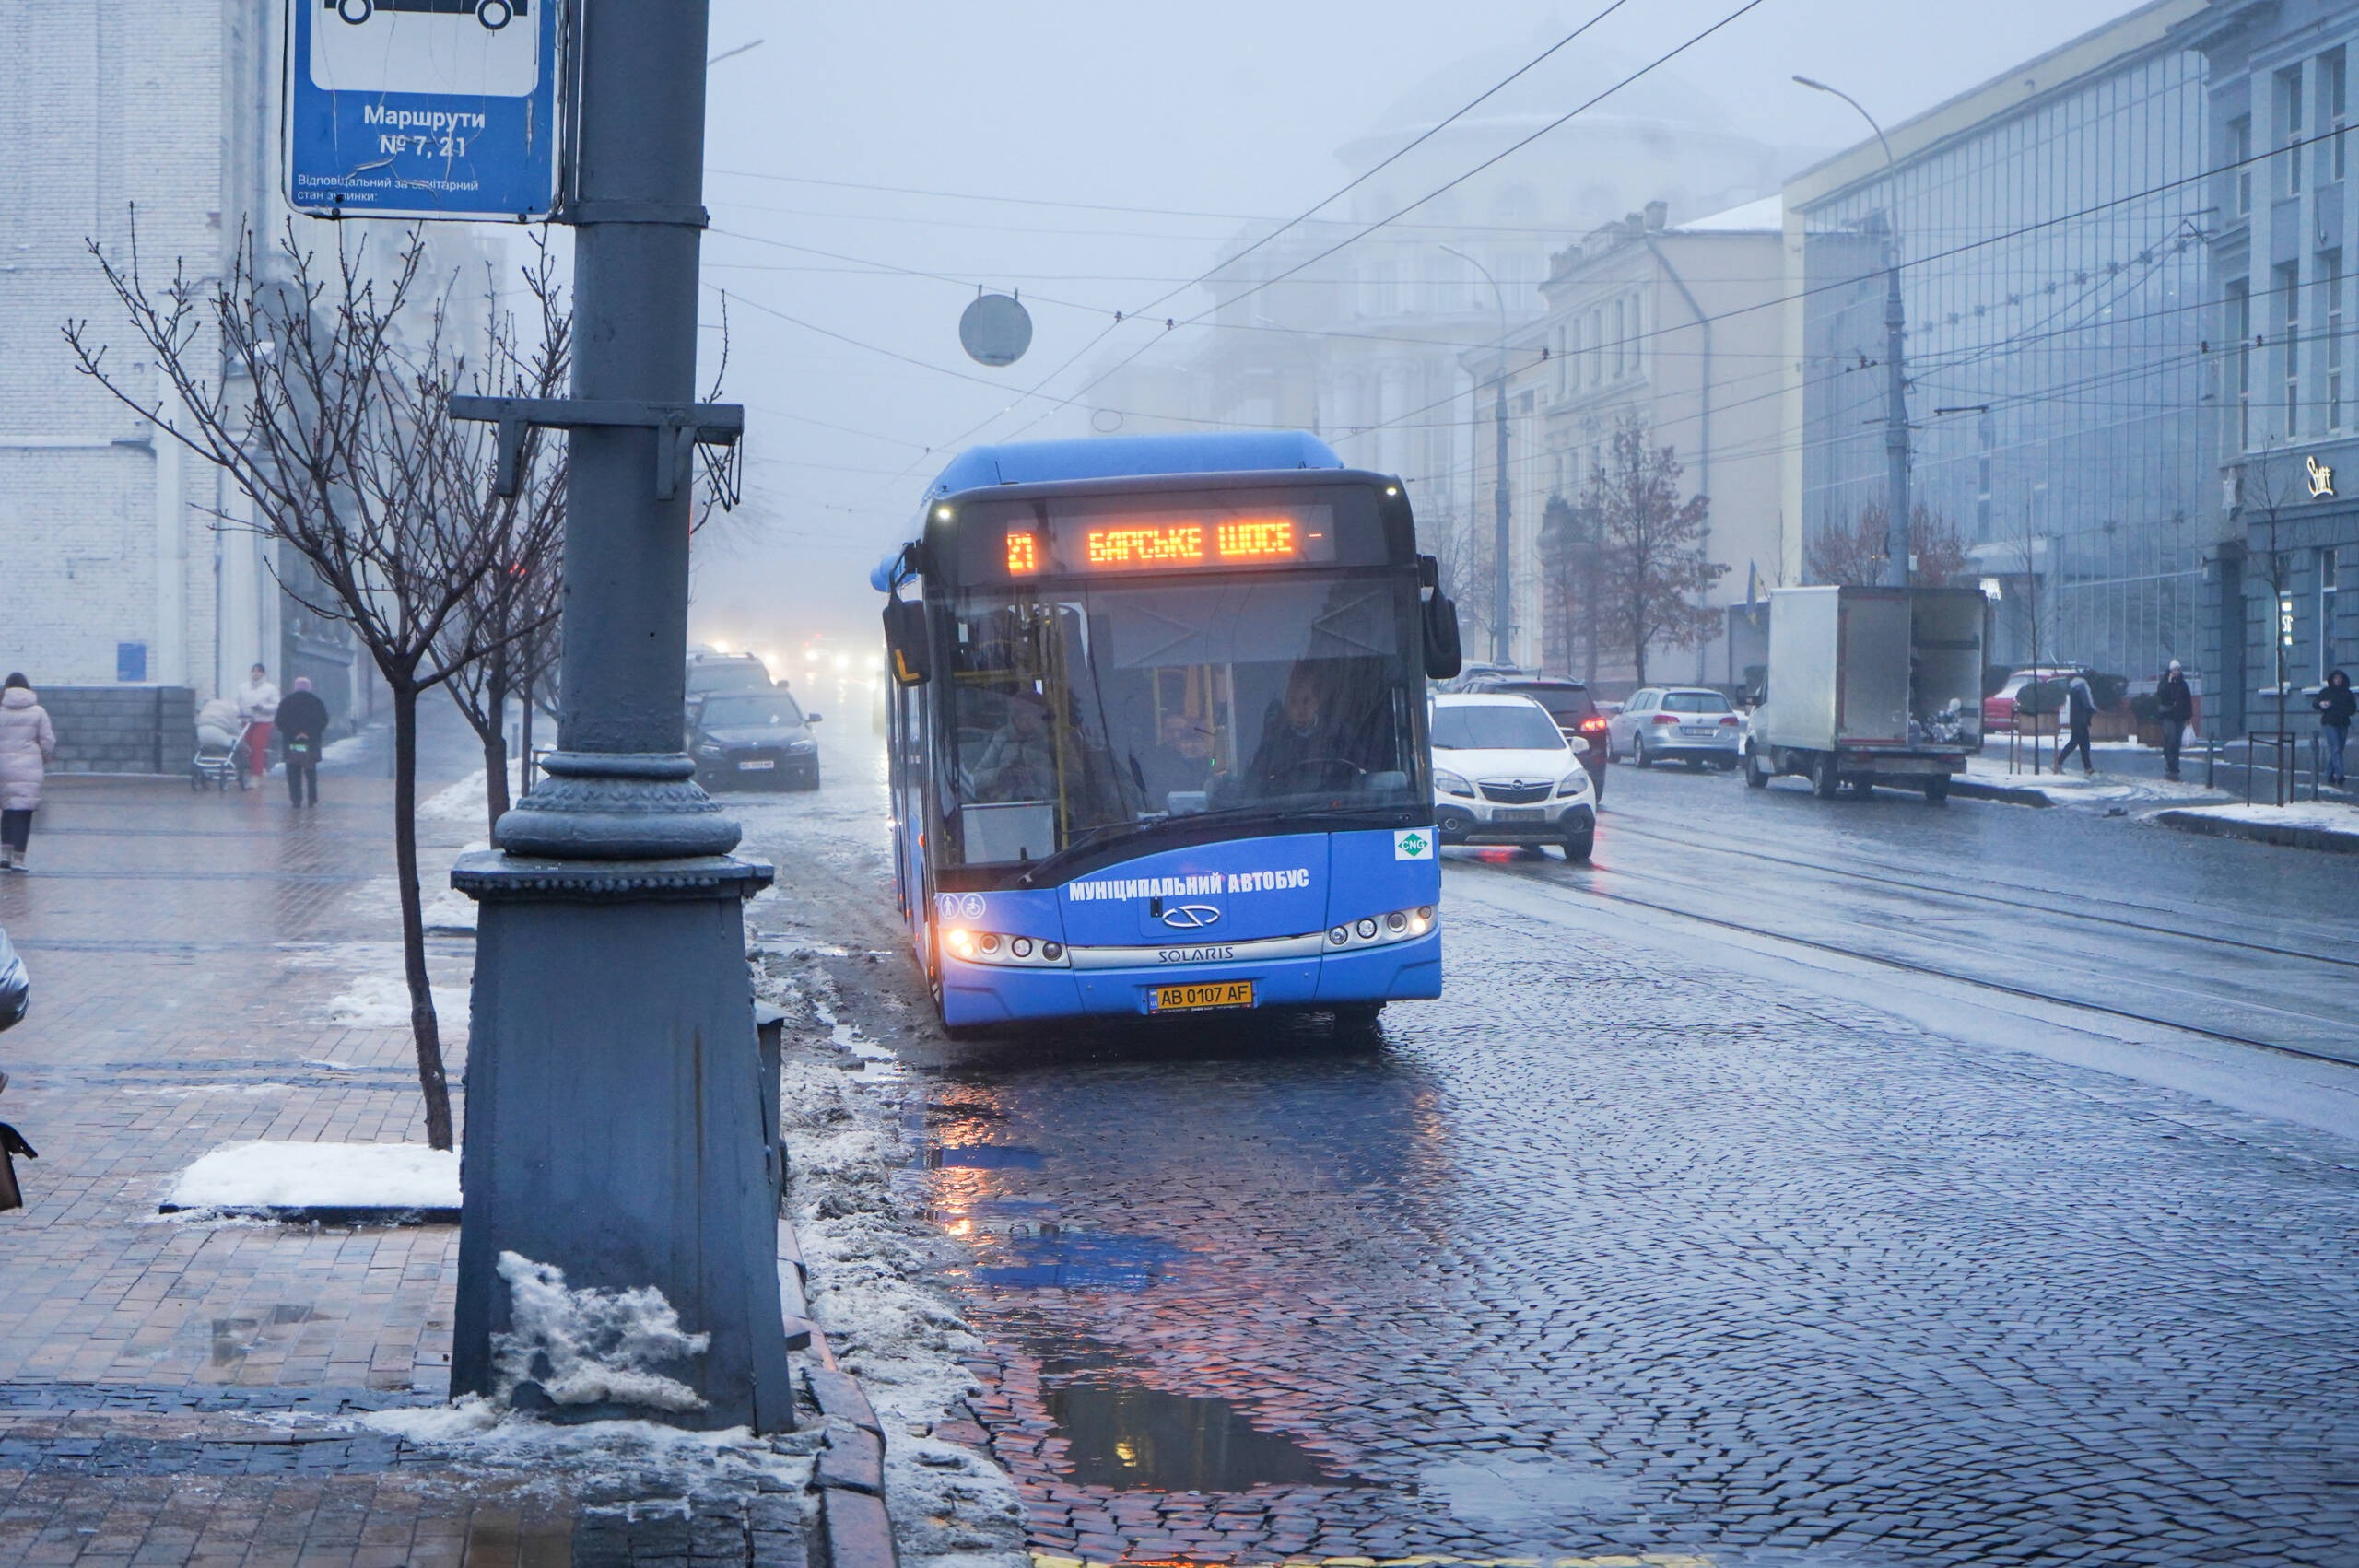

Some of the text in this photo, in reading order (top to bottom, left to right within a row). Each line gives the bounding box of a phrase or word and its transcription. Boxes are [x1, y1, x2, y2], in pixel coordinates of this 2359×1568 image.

[364, 104, 486, 132] Маршрути
[381, 134, 465, 159] № 7, 21
[394, 179, 408, 189] за
[297, 191, 323, 200] стан
[1006, 533, 1033, 569] 21
[1089, 528, 1203, 562] БАРСЬКЕ
[1218, 522, 1292, 556] ШОСЕ
[1401, 839, 1425, 851] CNG
[1069, 868, 1310, 902] МУНІЦИПАЛЬНИЙ АВТОБУС
[1158, 946, 1234, 964] SOLARIS
[1161, 985, 1249, 1006] AB 0107 AF
